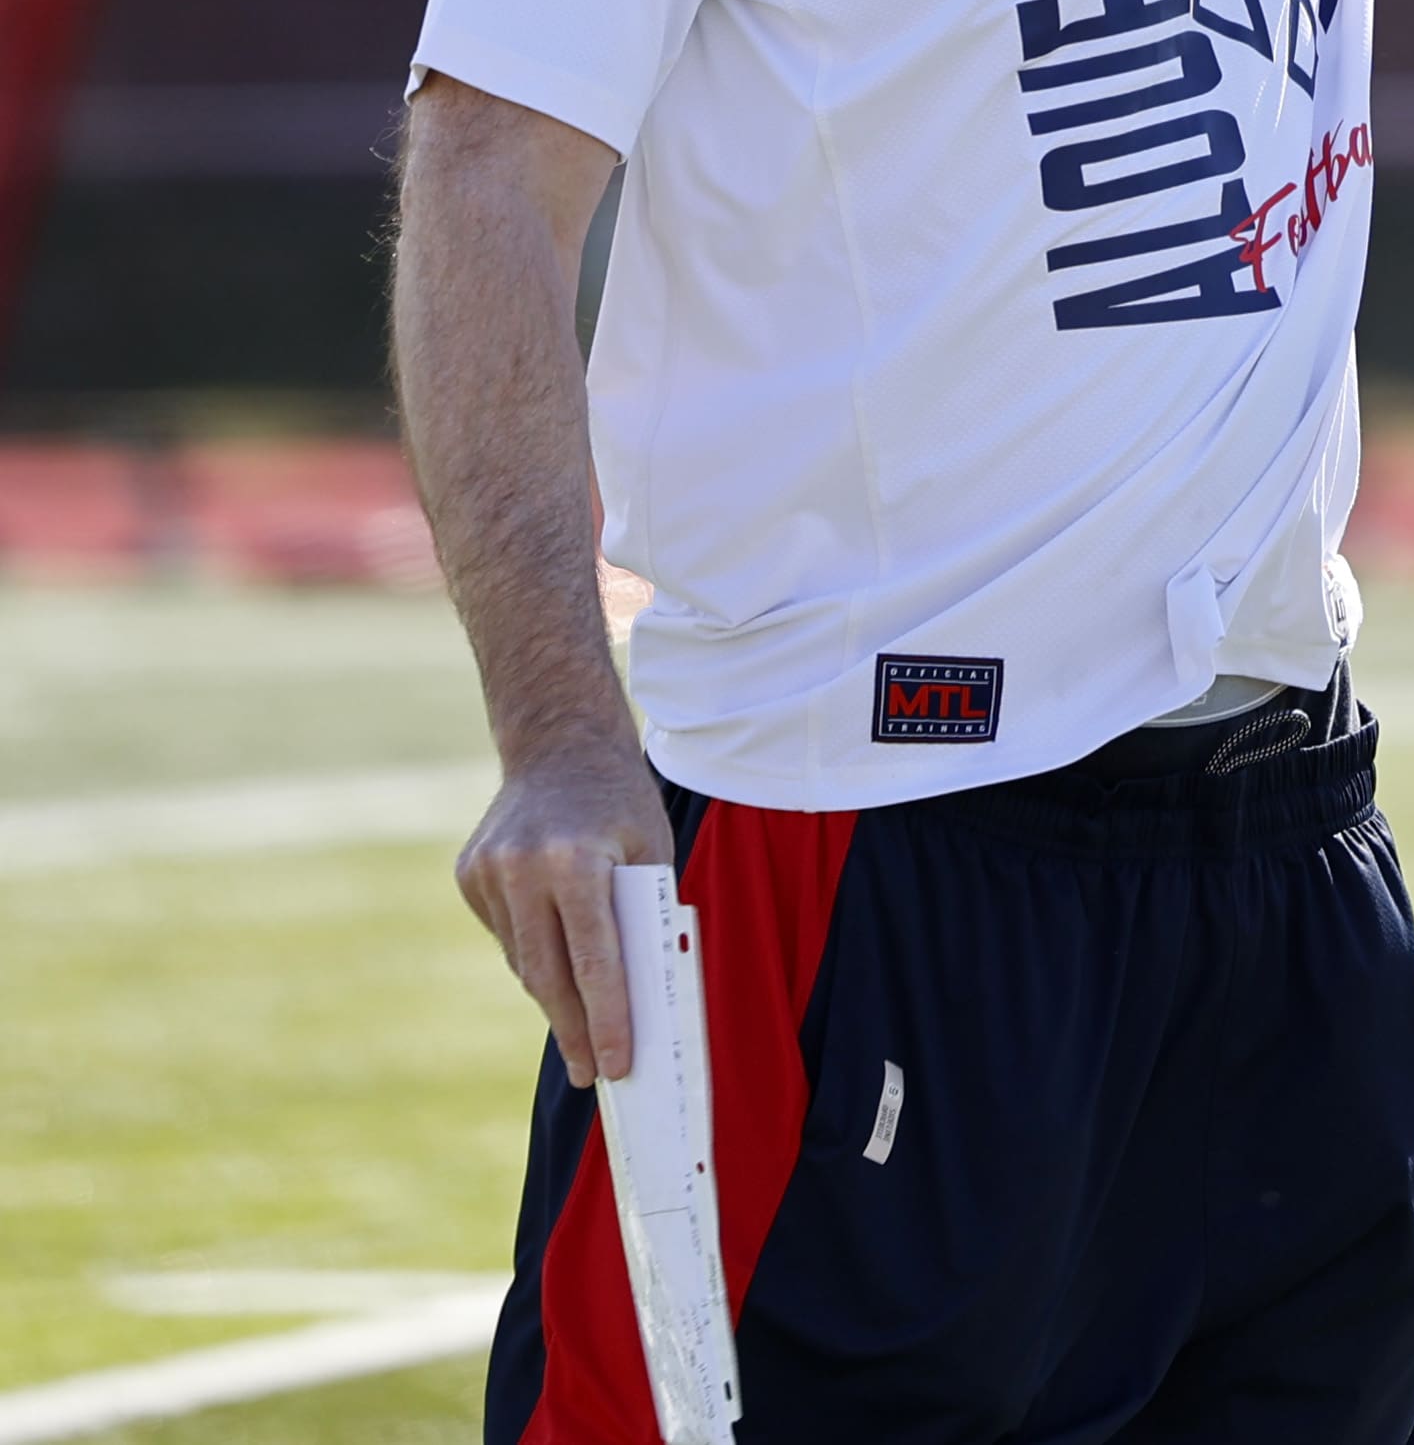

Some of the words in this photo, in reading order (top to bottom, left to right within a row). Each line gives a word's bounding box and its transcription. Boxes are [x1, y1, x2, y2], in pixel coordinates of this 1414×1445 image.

[889, 667, 991, 680] OFFICIAL
[887, 682, 988, 719] MTL
[887, 722, 986, 733] TRAINING
